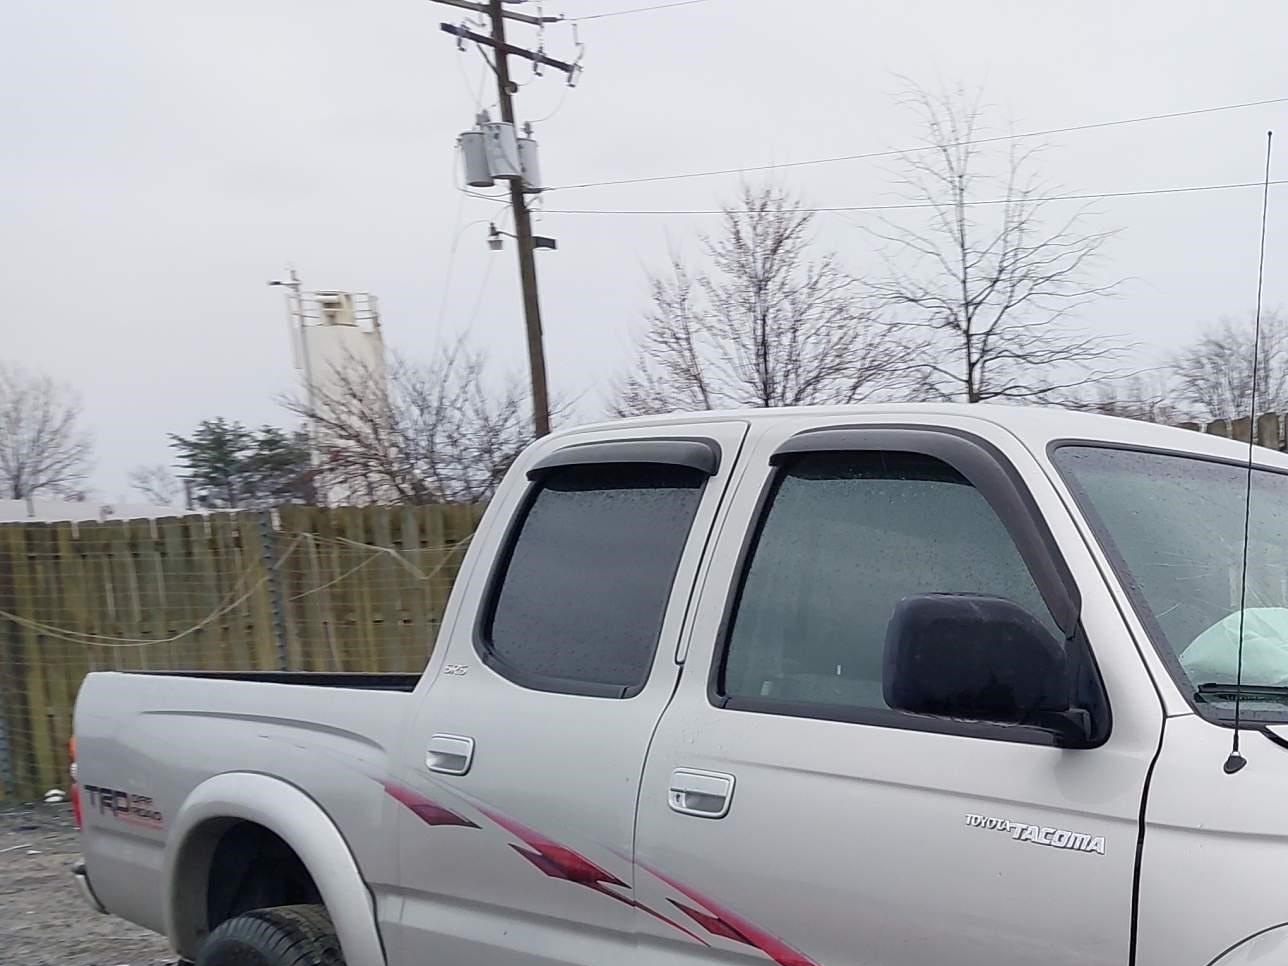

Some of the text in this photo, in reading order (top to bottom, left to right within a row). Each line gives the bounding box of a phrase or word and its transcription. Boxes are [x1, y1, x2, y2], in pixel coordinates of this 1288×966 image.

[84, 784, 129, 817] TRD
[965, 813, 1106, 856] TOYOTA TACOMA
